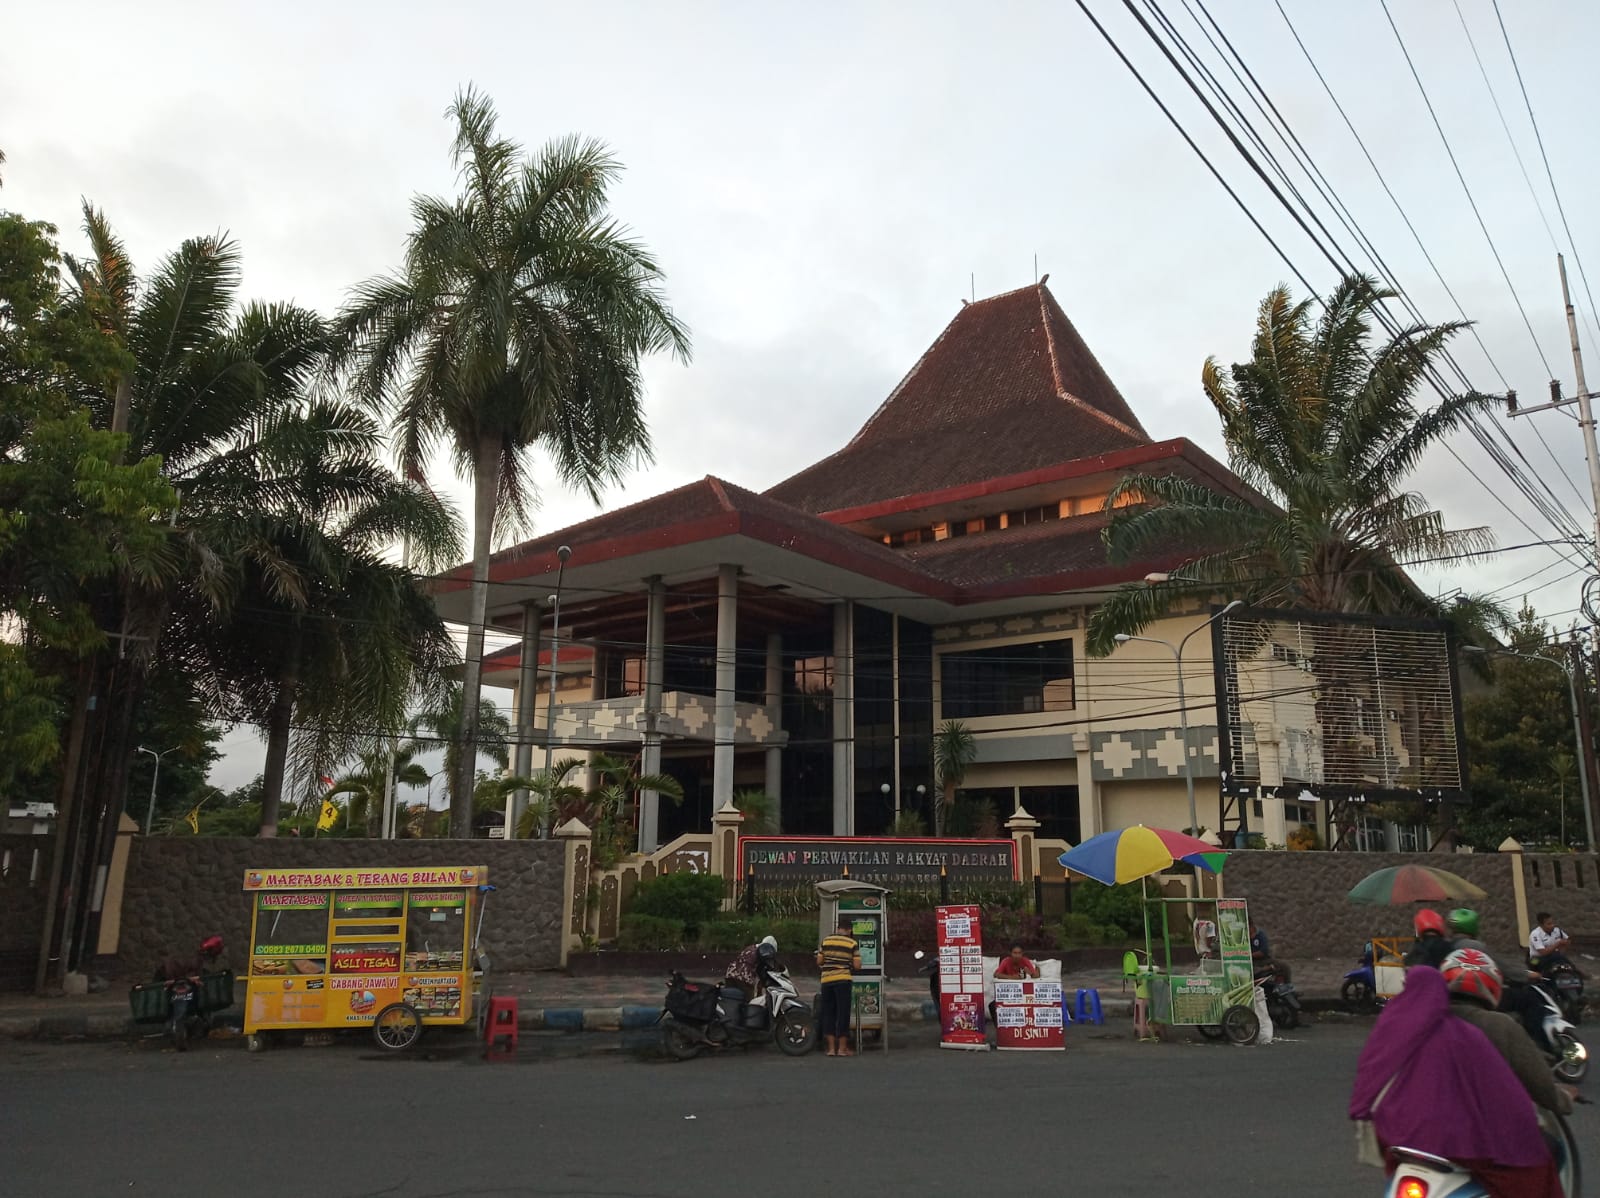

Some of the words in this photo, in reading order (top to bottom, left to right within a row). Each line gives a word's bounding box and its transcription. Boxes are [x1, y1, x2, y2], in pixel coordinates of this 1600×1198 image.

[325, 807, 333, 818] 4
[749, 850, 797, 864] DEWAN
[802, 850, 890, 865] PERWAKILAN
[895, 851, 948, 866] RAKYAT
[951, 852, 1008, 866] DAERAH
[266, 874, 343, 886] MARTABAK
[345, 875, 353, 884] &
[357, 872, 409, 885] TERANG
[411, 871, 457, 884] BULAN
[262, 894, 327, 906] MARTABAK
[441, 893, 464, 901] BULAN
[334, 958, 360, 969] ASLI
[363, 957, 397, 968] TEGAL
[330, 978, 363, 989] CABANG
[364, 978, 388, 989] JAWA
[389, 977, 398, 988] VI
[1014, 1027, 1023, 1038] DI
